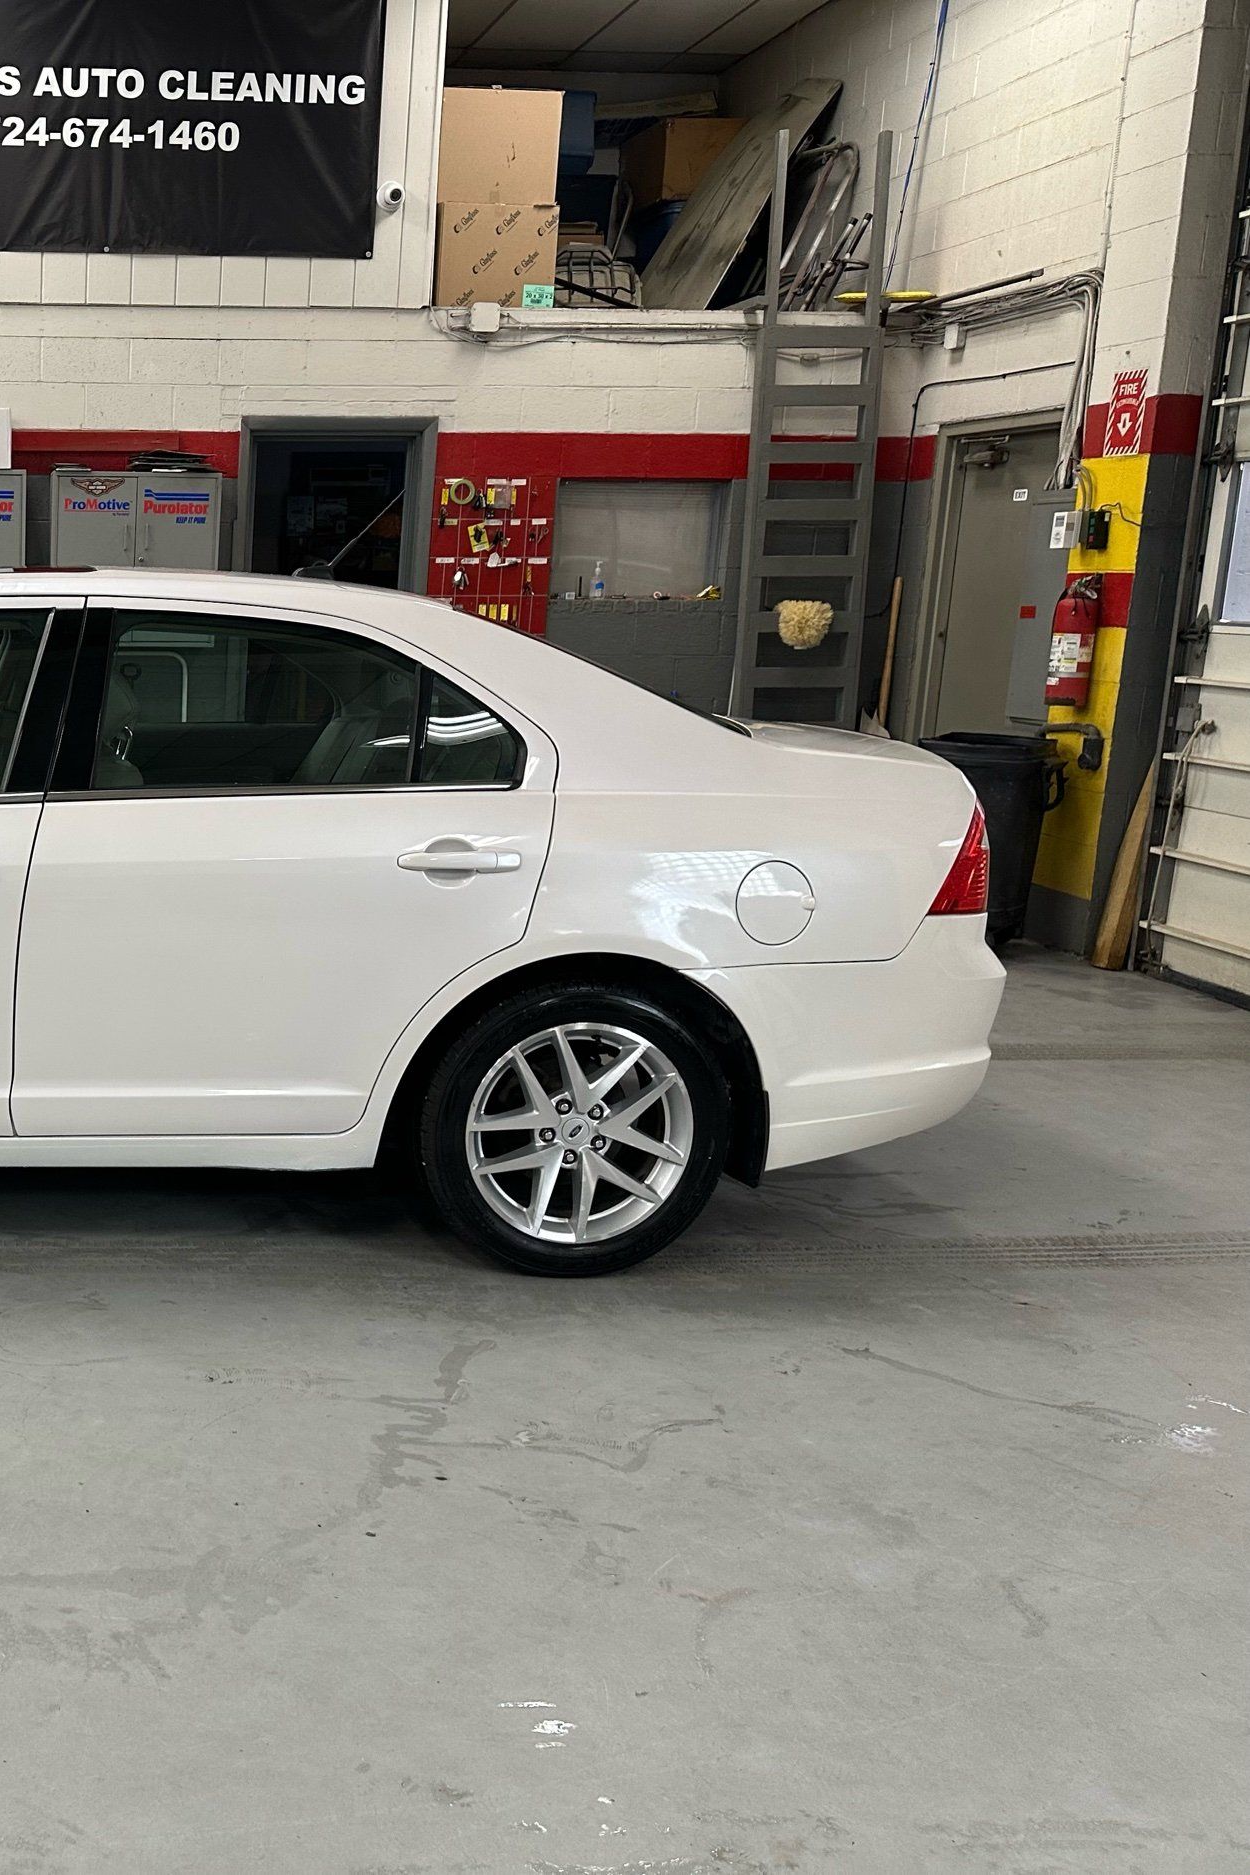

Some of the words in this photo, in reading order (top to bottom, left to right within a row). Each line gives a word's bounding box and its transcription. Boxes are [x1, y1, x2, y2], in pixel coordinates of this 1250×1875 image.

[33, 67, 145, 99] AUTO
[158, 71, 366, 105] CLEANING
[1119, 382, 1139, 396] FIRE
[1015, 491, 1026, 499] EXIT
[64, 498, 130, 510] ProMotive
[144, 500, 209, 514] Purolator
[176, 516, 187, 524] KEEP
